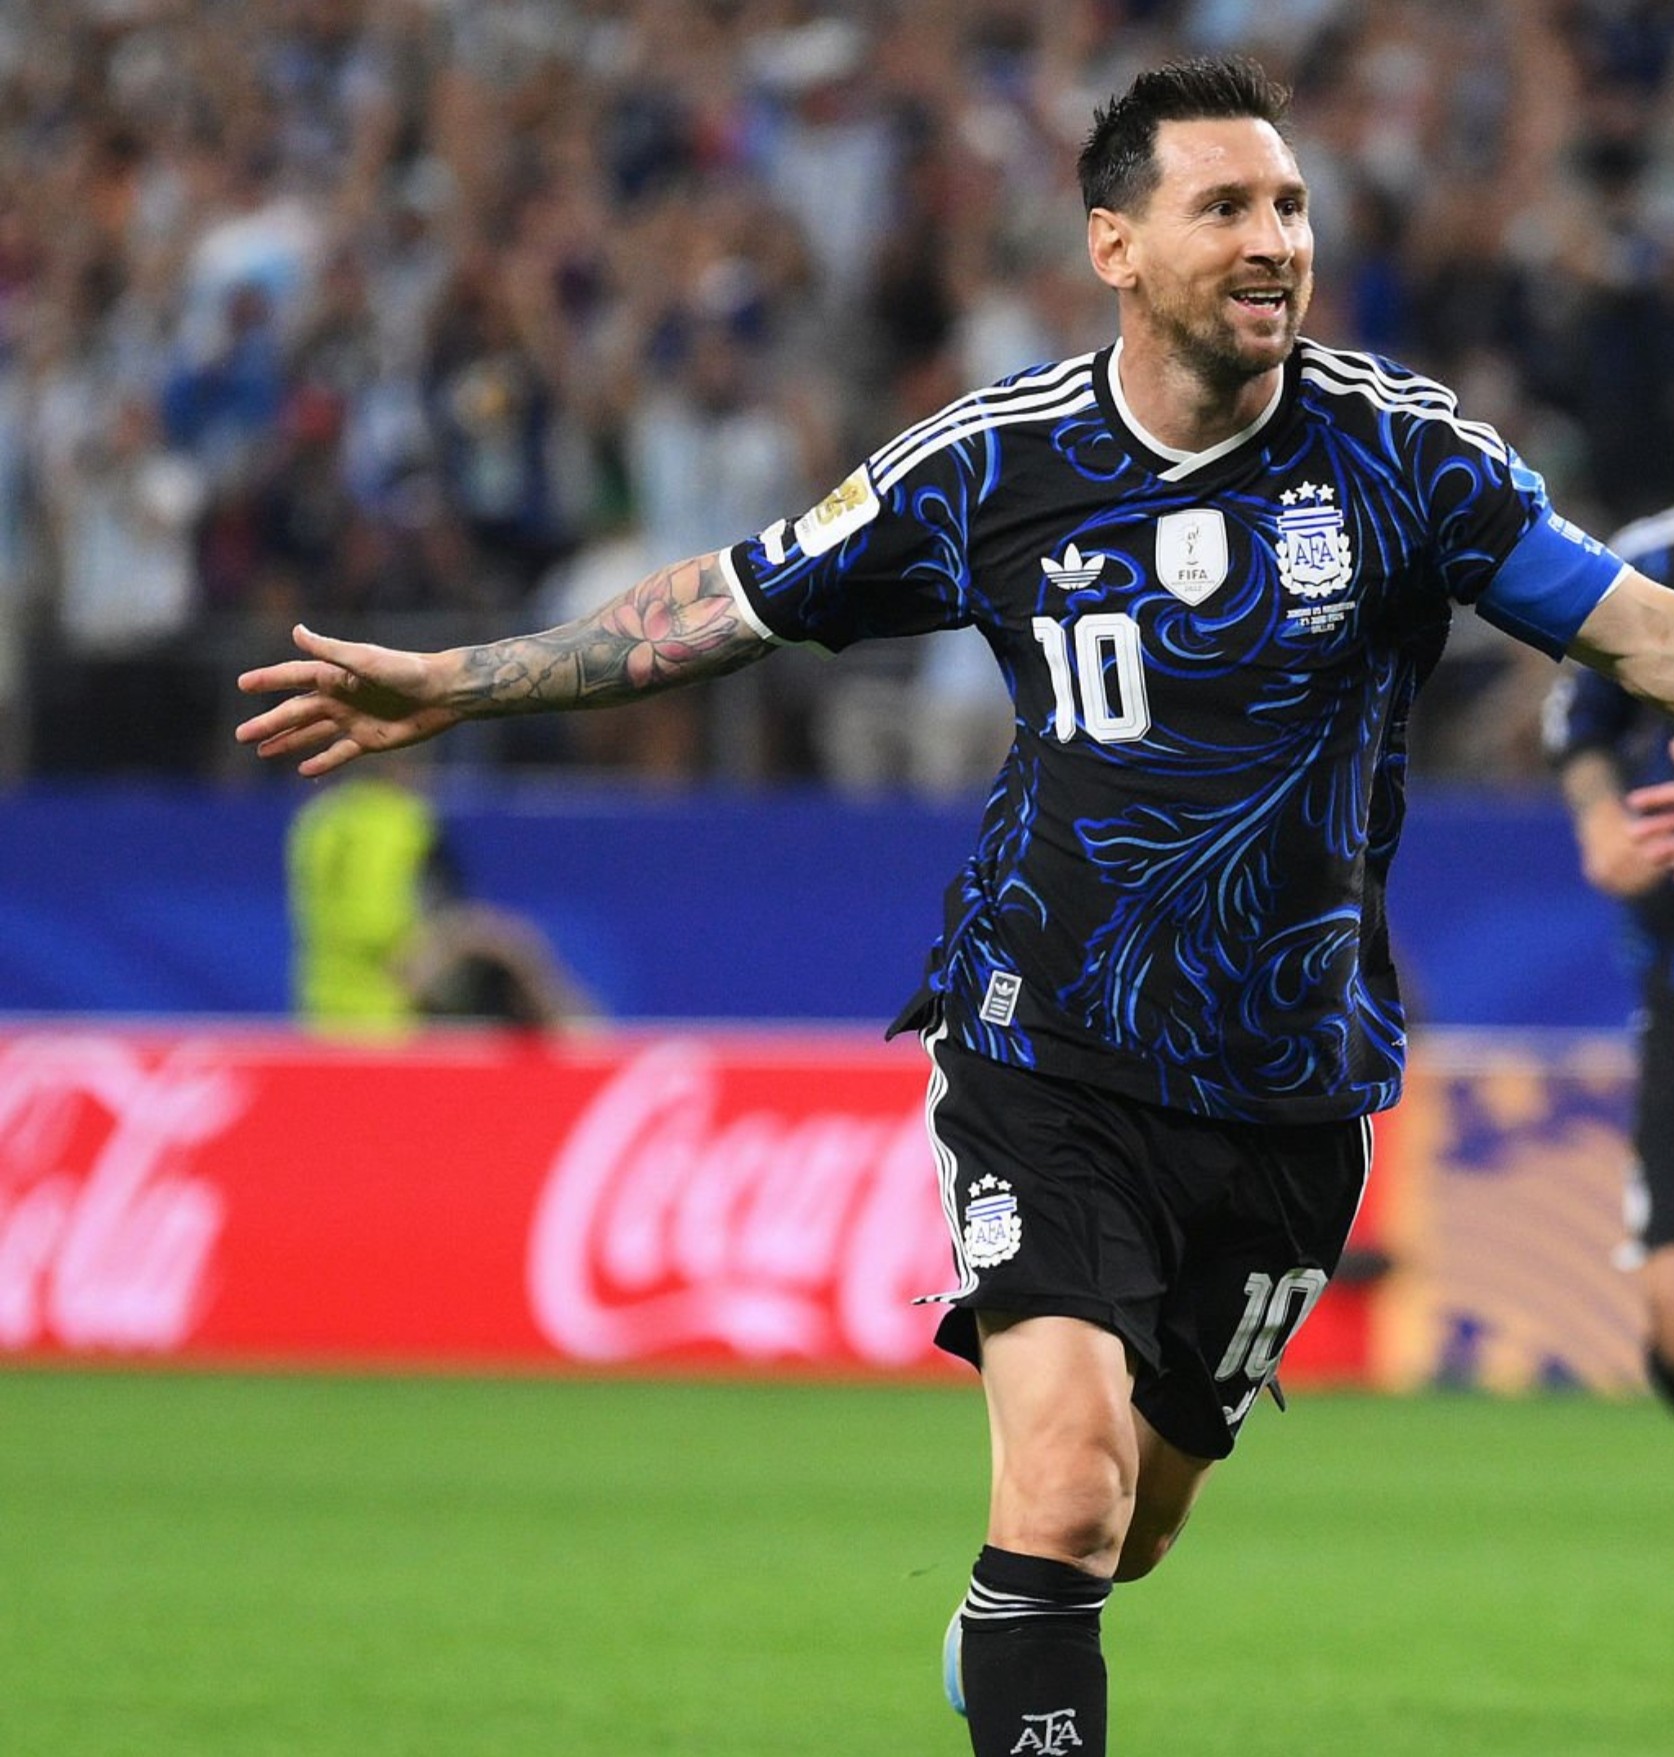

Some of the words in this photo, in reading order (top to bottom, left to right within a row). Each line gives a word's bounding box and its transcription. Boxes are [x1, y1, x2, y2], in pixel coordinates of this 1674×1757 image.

[1295, 531, 1335, 570] AFA
[1178, 569, 1208, 580] FIFA
[1032, 613, 1151, 744] 10
[975, 1215, 1006, 1245] AFA
[1214, 1268, 1329, 1382] 10
[1010, 1708, 1083, 1756] AFA
